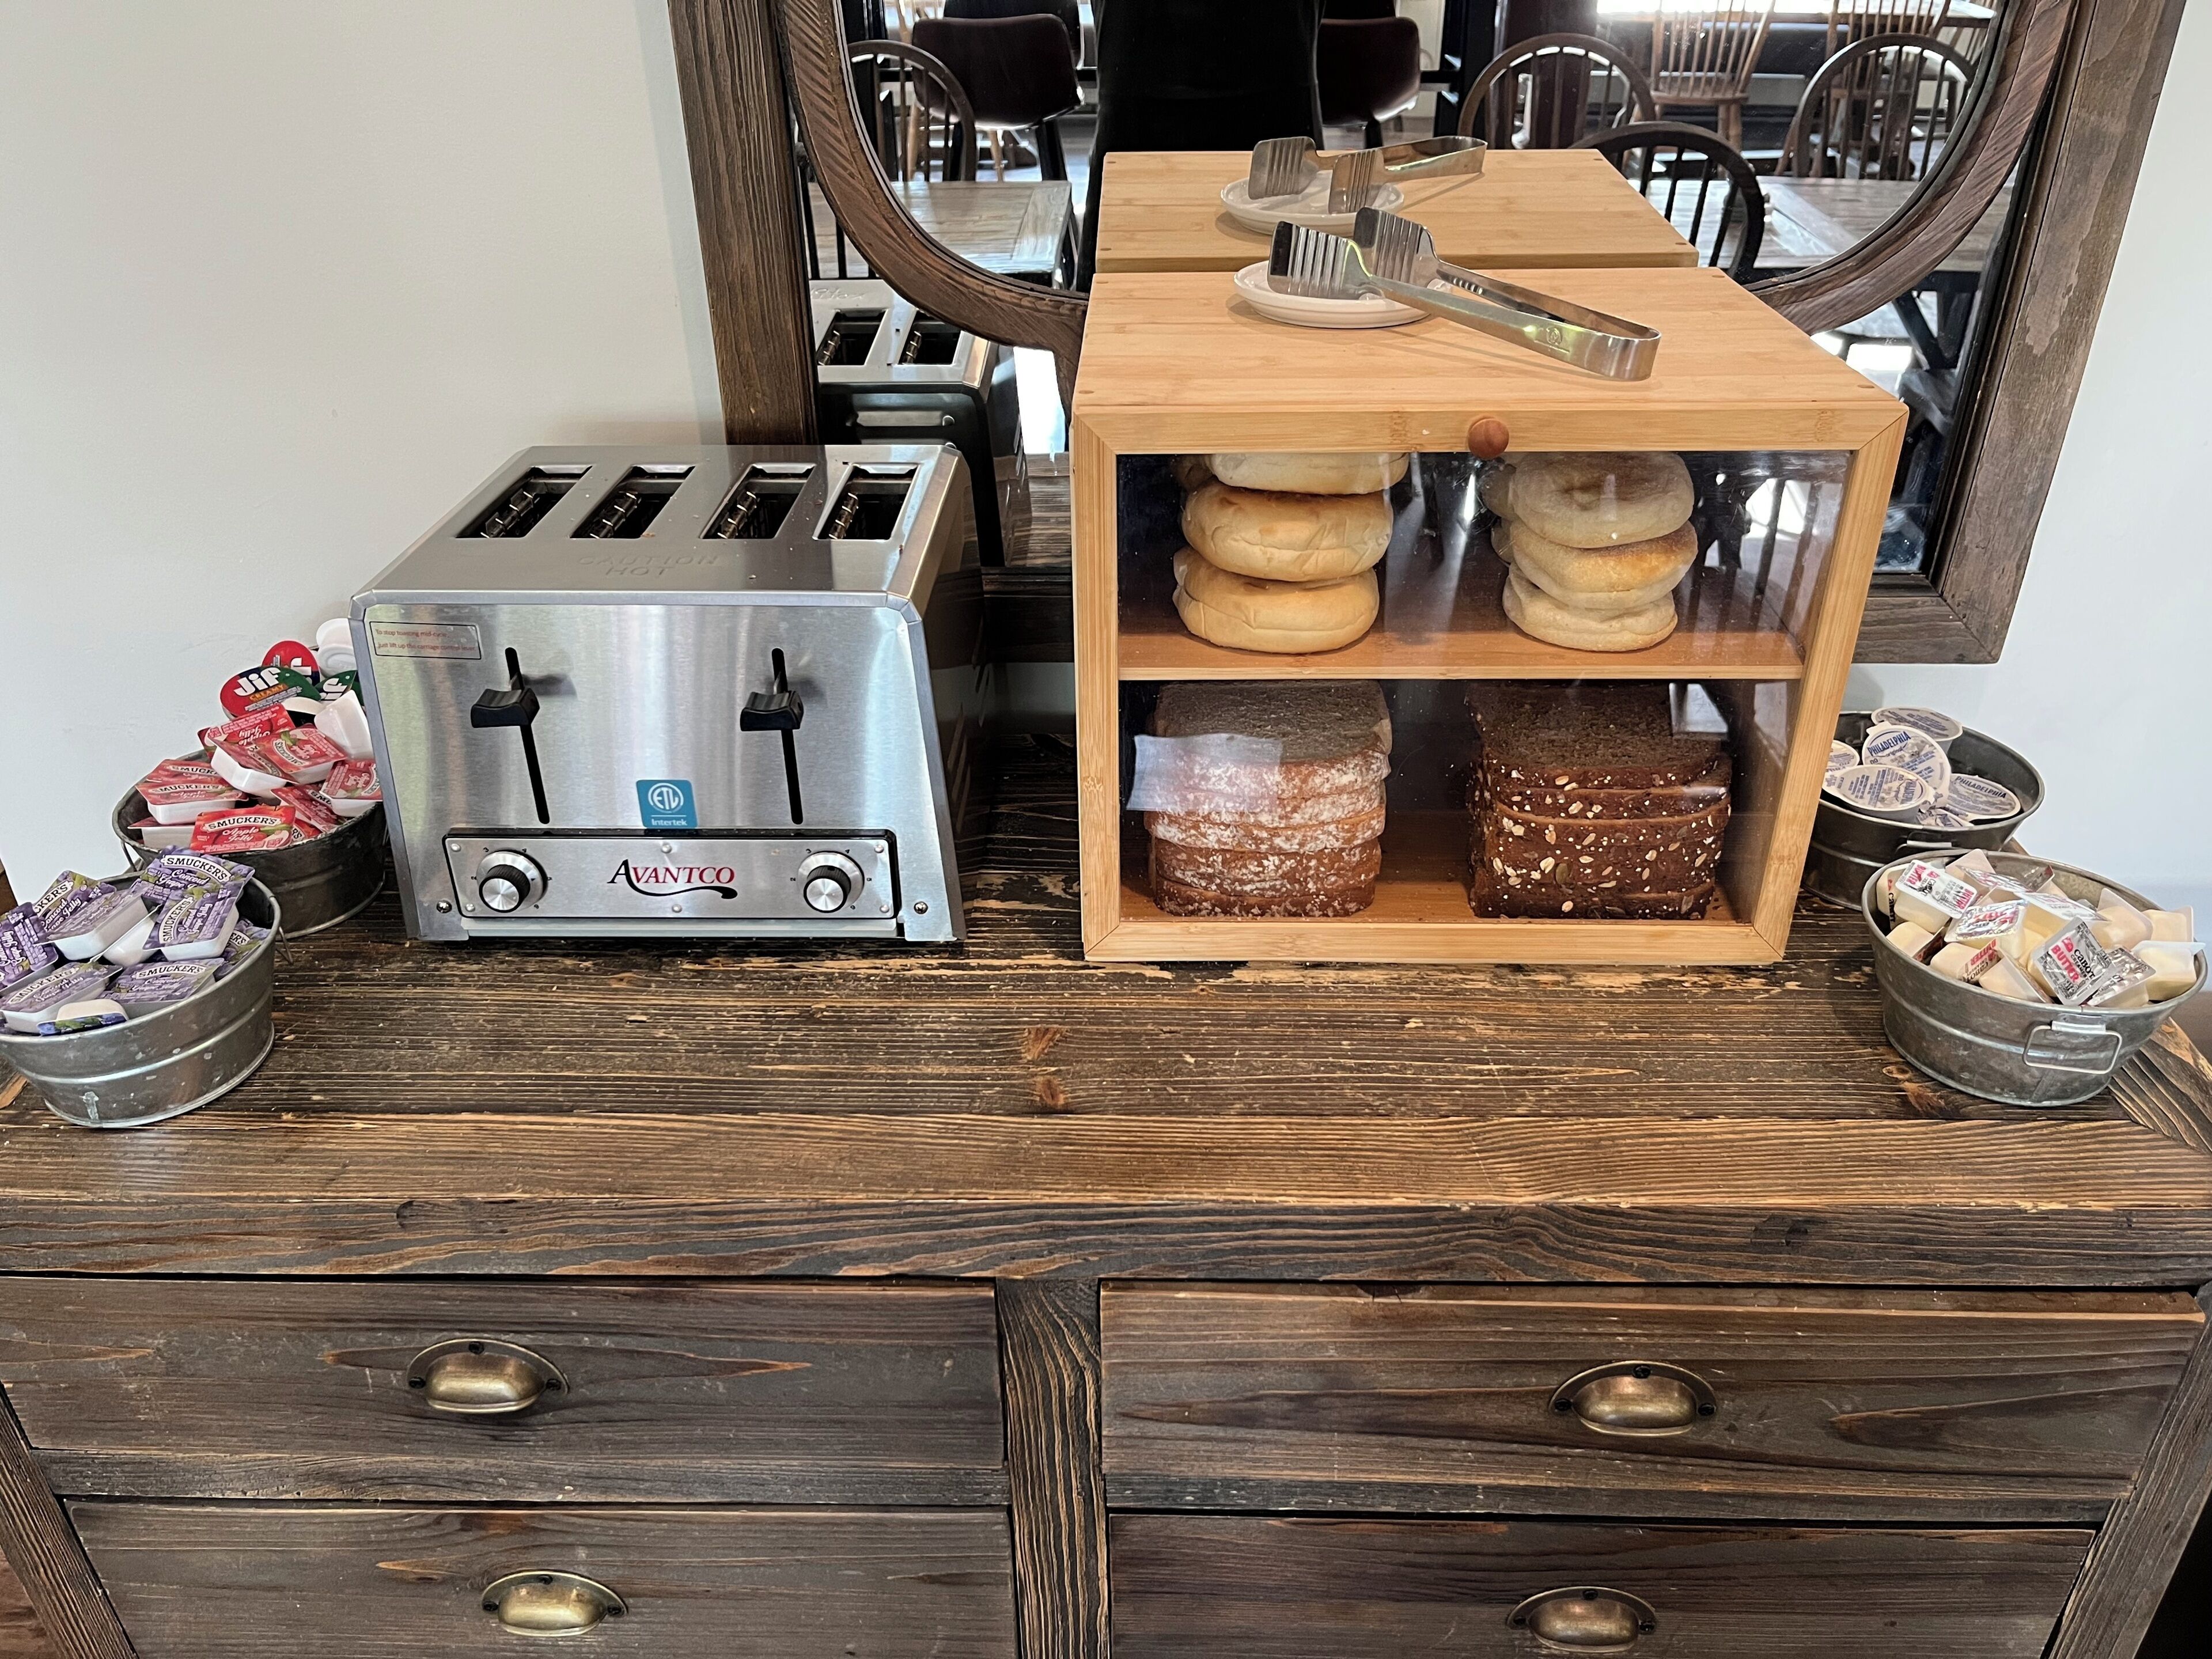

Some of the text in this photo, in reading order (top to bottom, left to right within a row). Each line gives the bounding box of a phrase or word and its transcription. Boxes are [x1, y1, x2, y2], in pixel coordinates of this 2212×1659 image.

[578, 555, 719, 566] CAUTION
[605, 566, 675, 575] HOT
[233, 667, 281, 696] Jif
[320, 677, 347, 700] if
[1867, 731, 1911, 756] PHILADELPHIA
[1955, 775, 2007, 799] PHILADELPHIA
[209, 817, 277, 829] SMUCKER'S
[222, 827, 259, 836] Apple
[225, 834, 254, 843] Jelly
[166, 857, 228, 882] SMUCKER'S
[172, 869, 210, 885] Concord
[607, 858, 736, 888] AVANTCO
[163, 900, 191, 942] SMUCKER'S
[139, 965, 203, 978] SMUCKER'S
[2051, 944, 2081, 983] BUTTER
